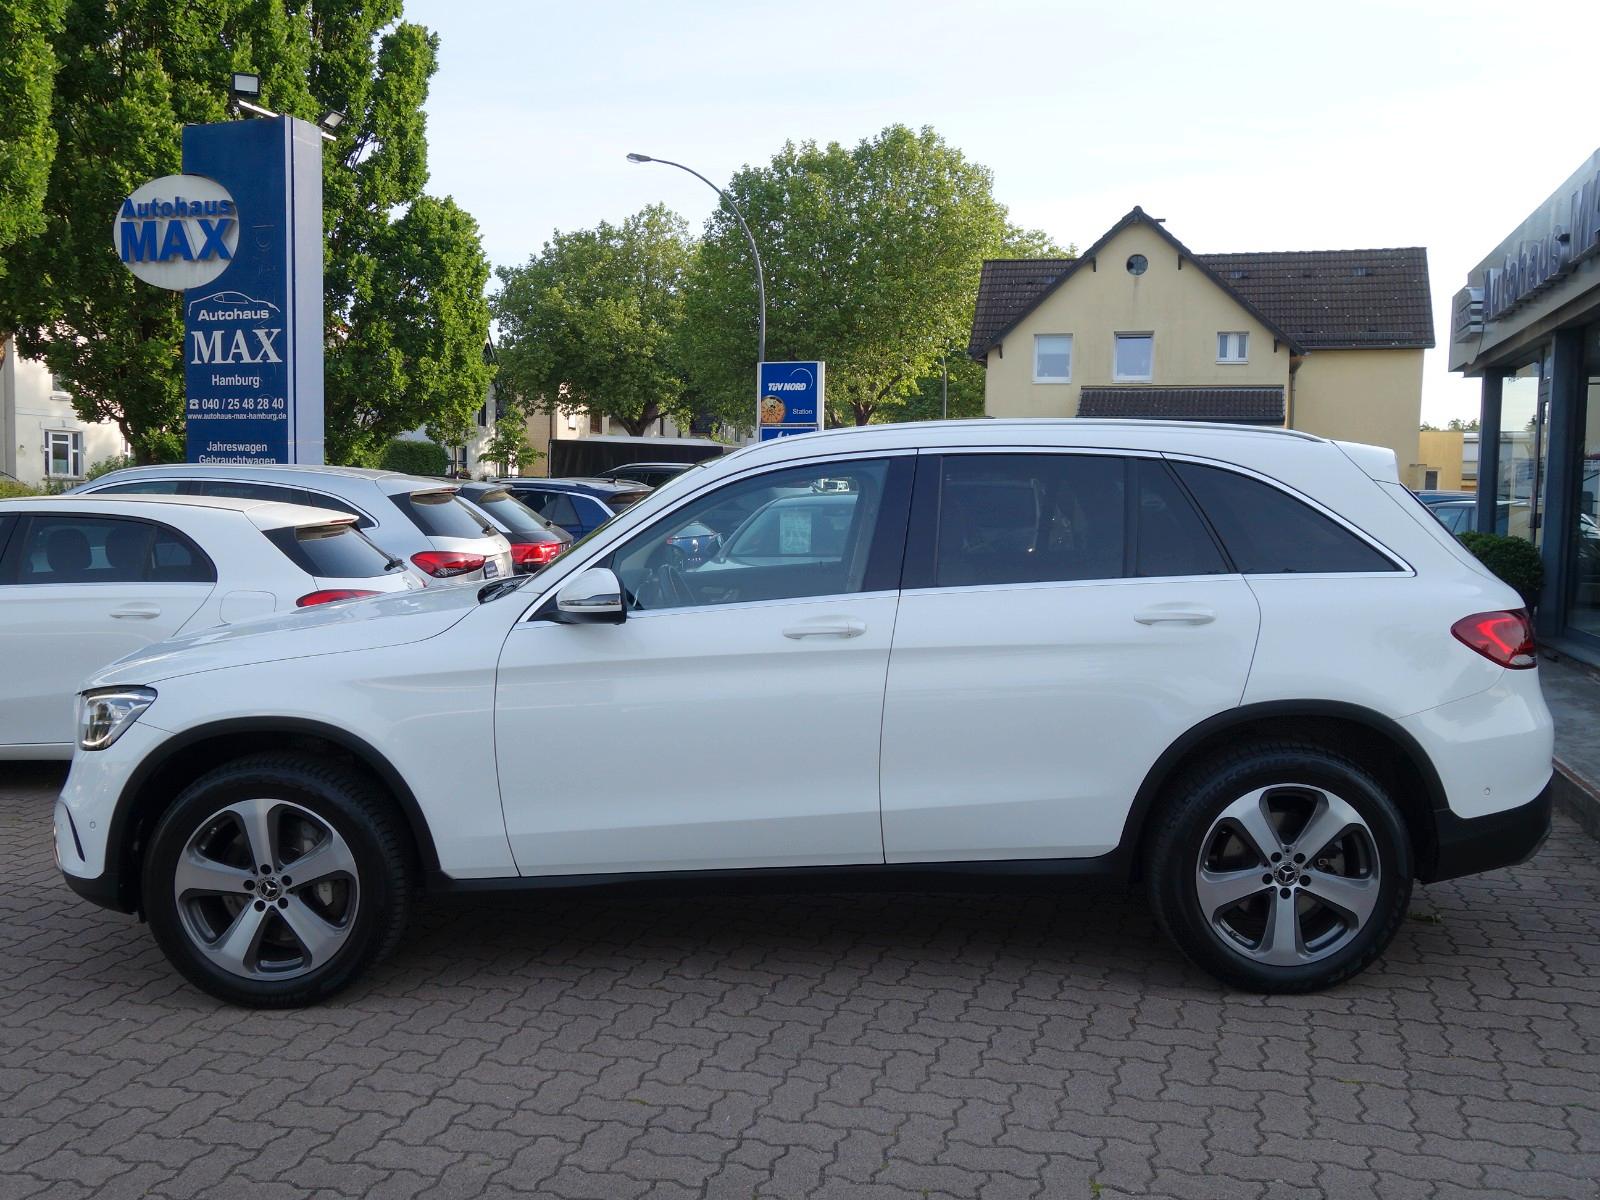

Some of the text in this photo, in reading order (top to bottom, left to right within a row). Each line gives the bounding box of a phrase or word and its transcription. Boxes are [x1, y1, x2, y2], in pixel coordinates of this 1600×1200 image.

[121, 196, 234, 218] Autohaus
[120, 218, 234, 263] MAX
[198, 308, 269, 321] Autohaus
[190, 328, 283, 365] MAX
[211, 374, 260, 388] Hamburg
[768, 382, 807, 391] TÜV NORD
[202, 398, 219, 409] 040
[228, 398, 240, 409] 25
[242, 398, 254, 409] 48
[257, 398, 269, 409] 28
[272, 398, 284, 409] 40
[187, 412, 287, 421] www.autohaus-max-hamburg.de
[206, 441, 268, 454] Jahreswagen
[198, 454, 276, 464] Gebrauchtwagen
